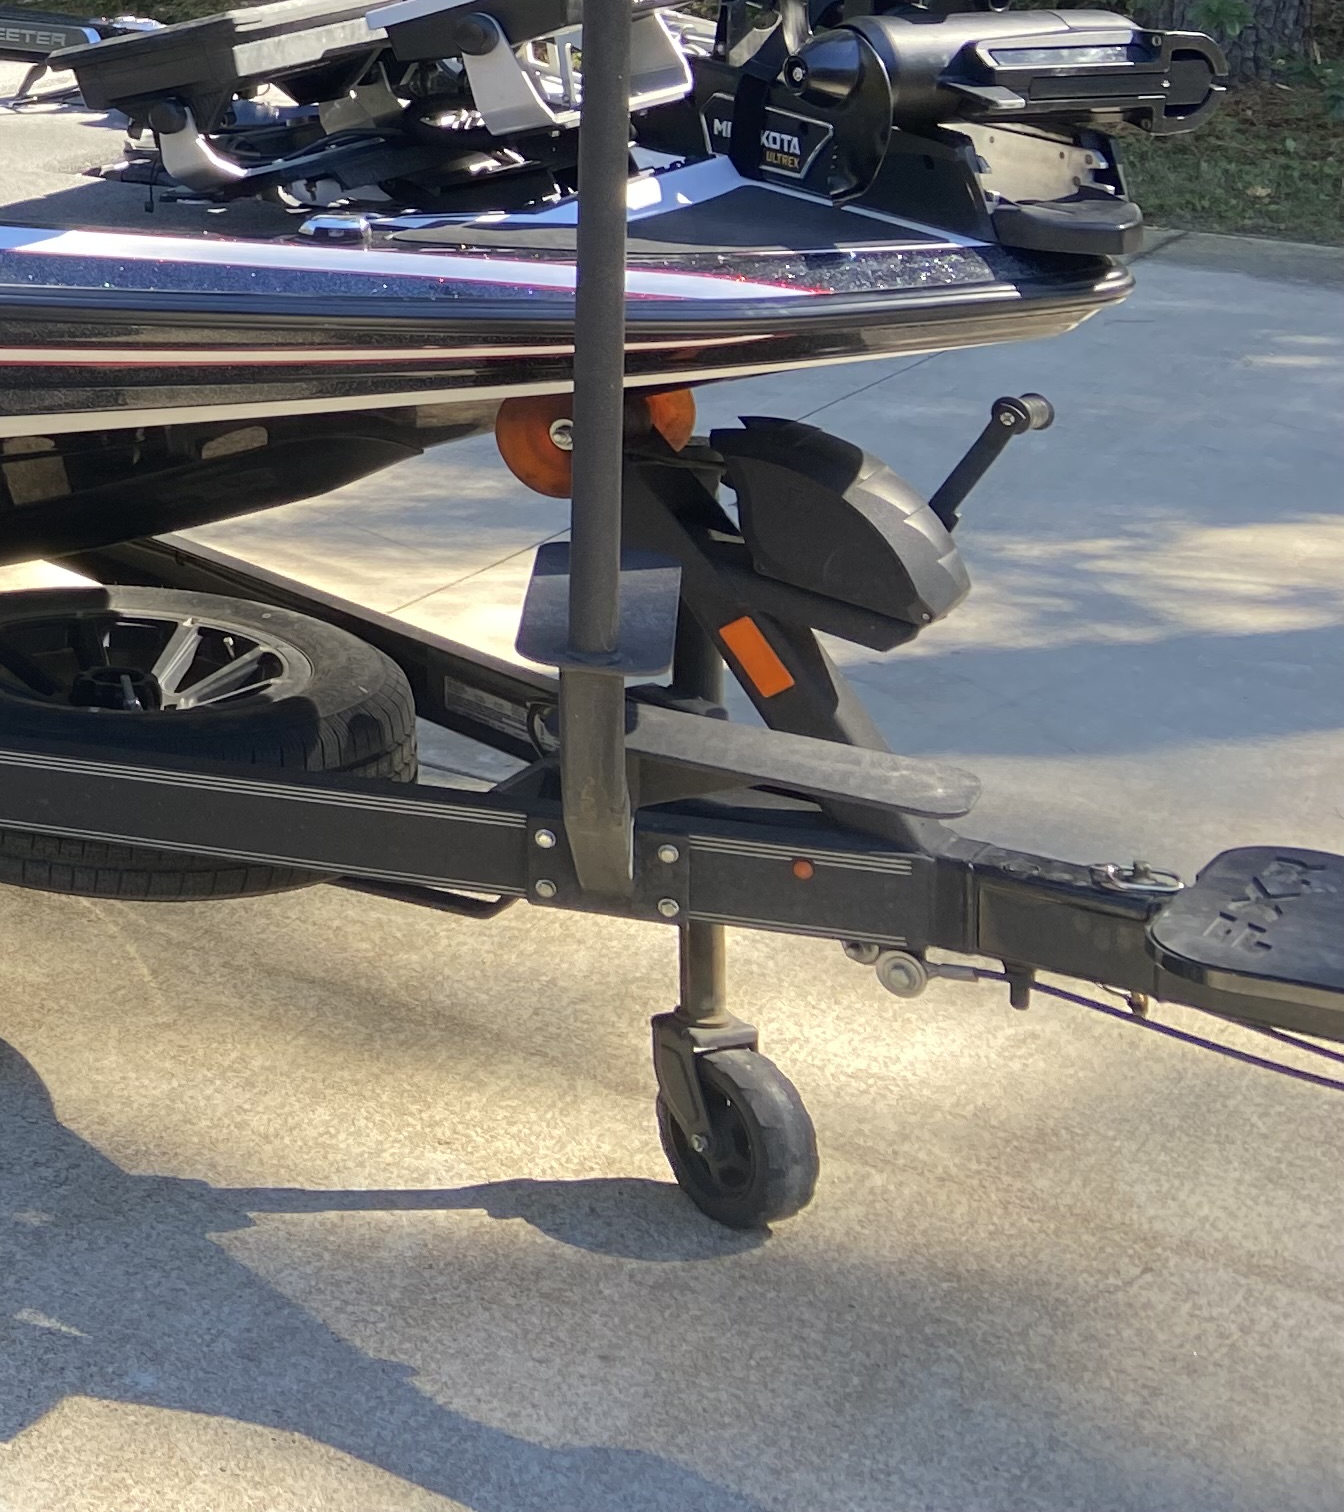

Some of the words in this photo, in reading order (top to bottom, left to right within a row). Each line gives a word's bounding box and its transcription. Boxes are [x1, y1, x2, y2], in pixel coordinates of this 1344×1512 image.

[713, 118, 732, 138] MI
[760, 129, 801, 155] KOTA
[766, 150, 800, 168] ULTREX
